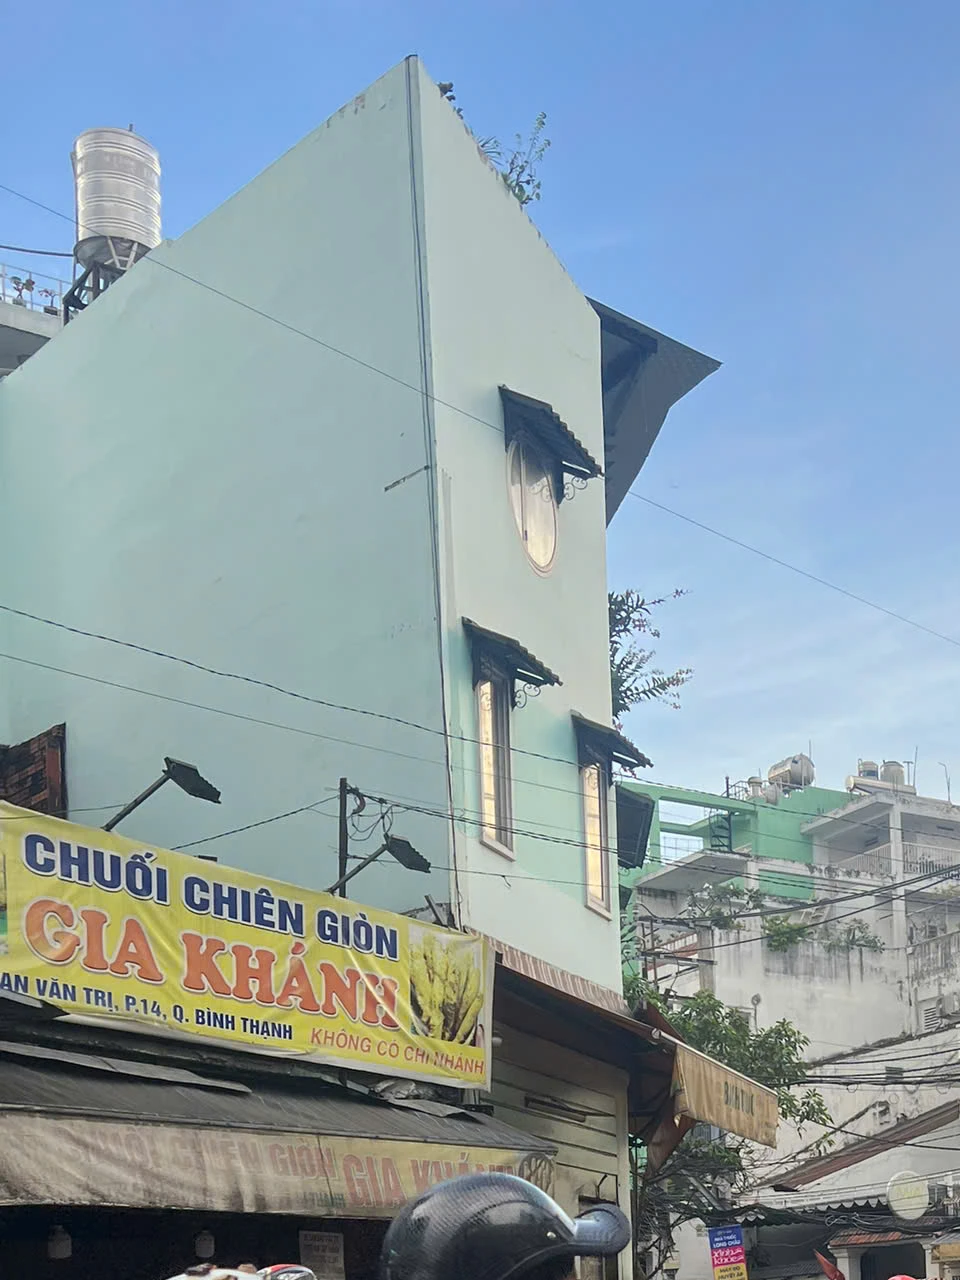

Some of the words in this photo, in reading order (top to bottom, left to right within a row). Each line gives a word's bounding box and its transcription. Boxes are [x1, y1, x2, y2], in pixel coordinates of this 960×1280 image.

[24, 833, 168, 904] CHUỐI
[184, 876, 305, 936] CHIÊN
[317, 909, 399, 960] GIÒN
[25, 899, 164, 982] GIA
[181, 932, 400, 1028] KHÁNH
[36, 978, 76, 1001] VĂN
[173, 1004, 189, 1022] Q.
[195, 1007, 236, 1031] BÌNH
[241, 1016, 293, 1040] THẠNH
[311, 1028, 371, 1053] KHÔNG
[343, 1154, 407, 1209] GIA
